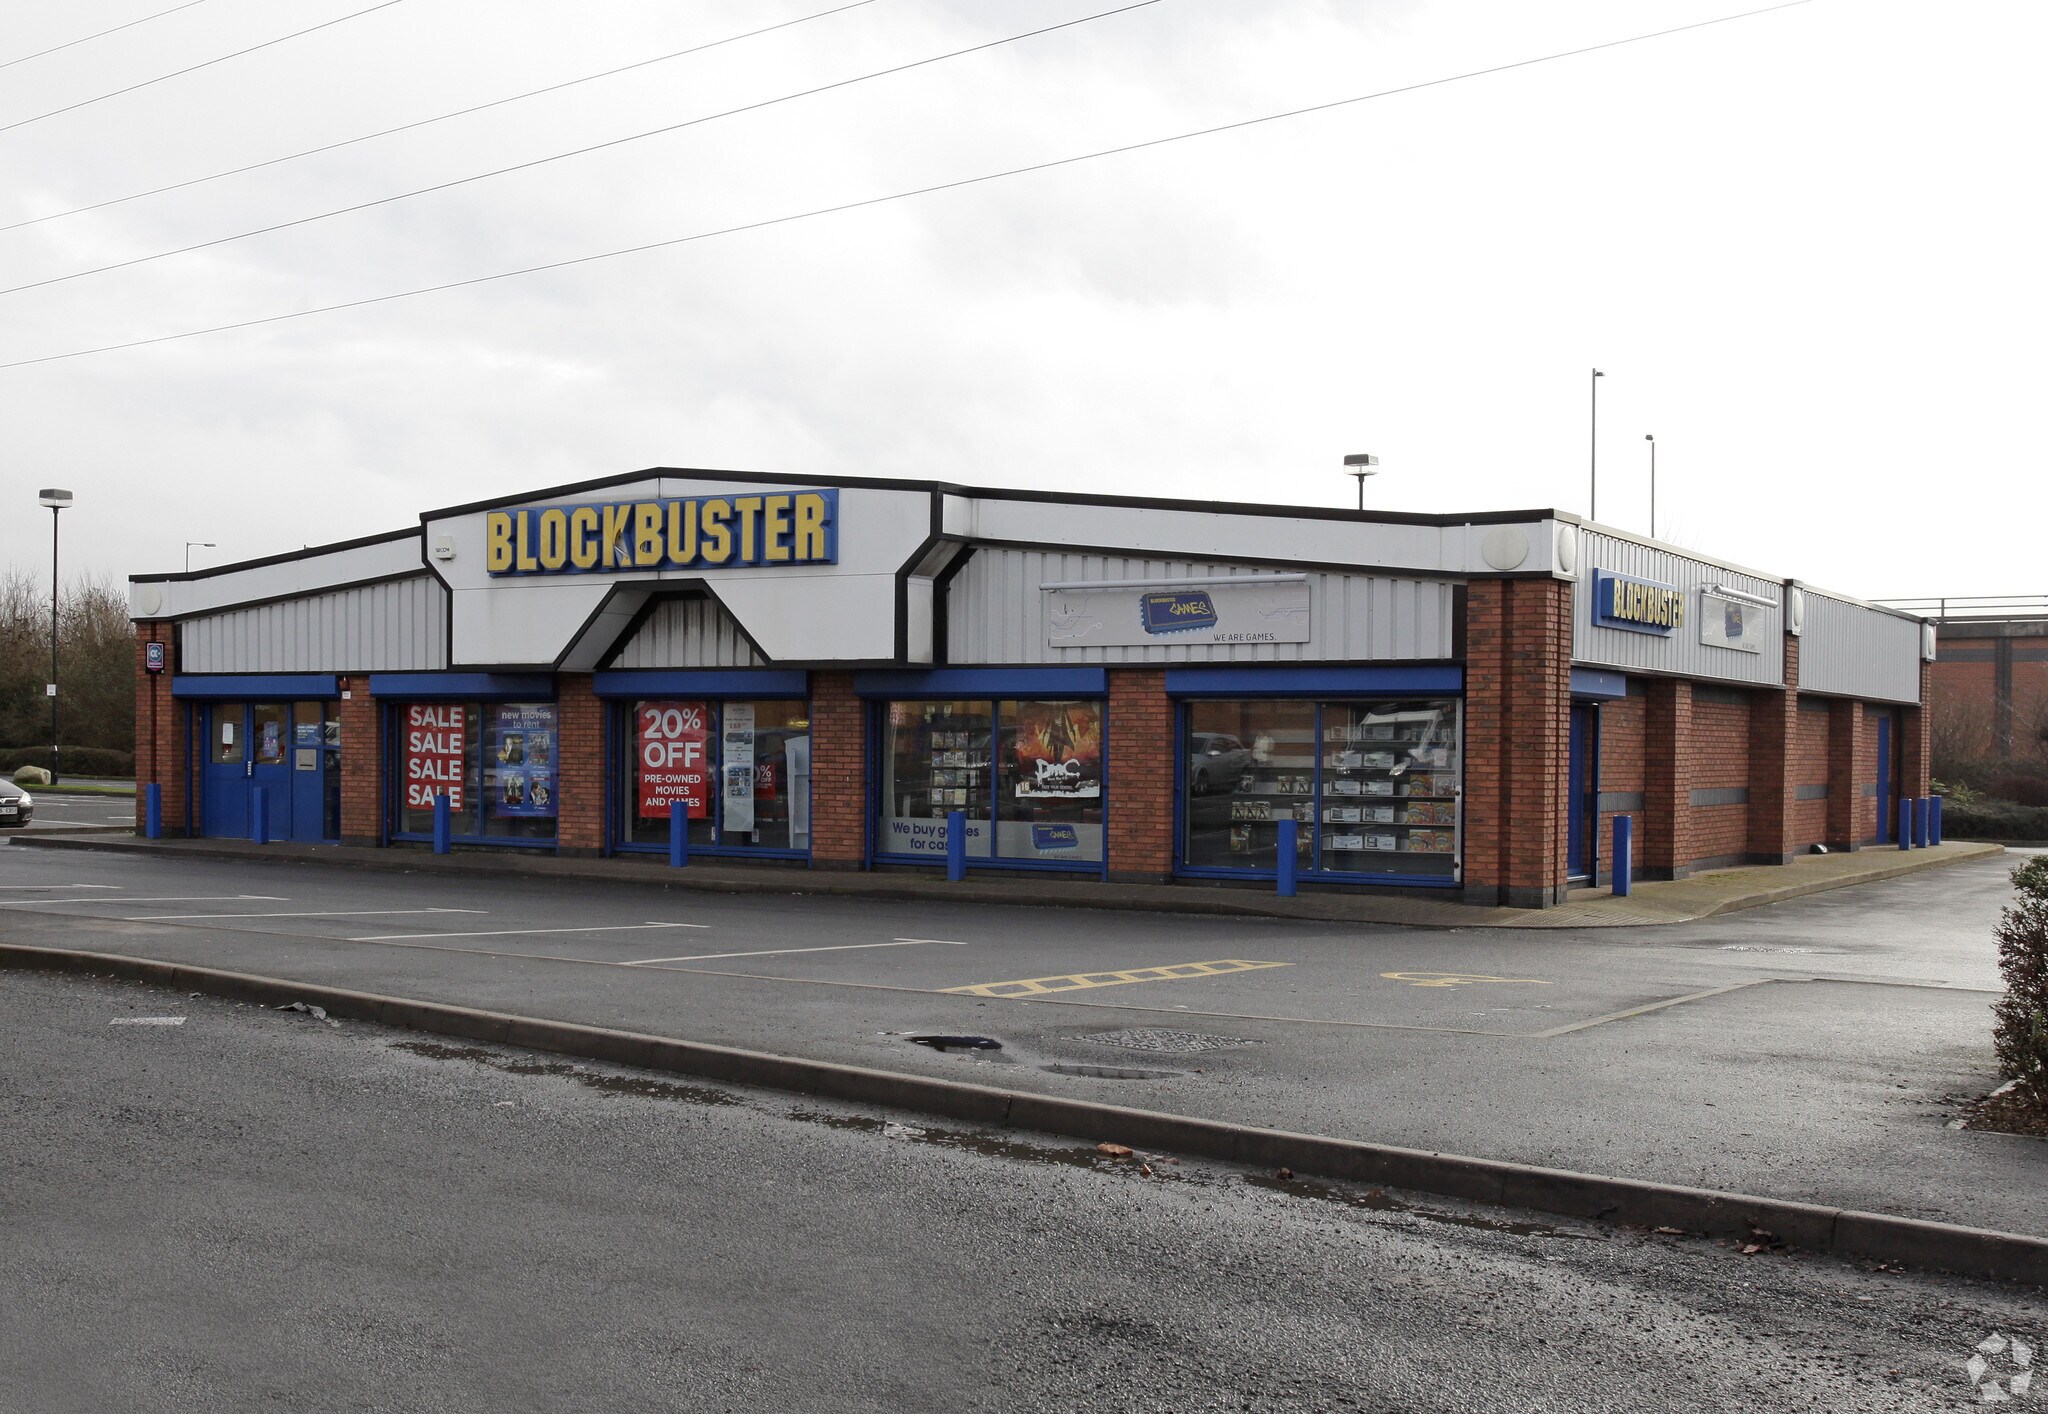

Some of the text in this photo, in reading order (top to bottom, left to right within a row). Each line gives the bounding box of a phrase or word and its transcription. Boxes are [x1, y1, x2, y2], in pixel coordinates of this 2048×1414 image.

[487, 493, 829, 573] BLOCKBUSTER
[1169, 601, 1211, 616] GAMES
[1613, 578, 1685, 628] BLOCKBUSTER
[1213, 632, 1277, 642] WE ARE GAMES.
[409, 705, 463, 728] SALE
[501, 710, 552, 720] new movies
[513, 721, 521, 729] to
[644, 707, 702, 739] 20%
[409, 732, 462, 754] SALE
[644, 742, 702, 768] OFF
[408, 758, 462, 781] SALE
[644, 774, 701, 784] PRE-OWNED
[1021, 781, 1030, 791] 16
[408, 784, 461, 808] SAE
[655, 786, 690, 795] MOVIES
[645, 797, 700, 807] AND GES
[892, 822, 980, 838] We buy ges
[910, 838, 949, 850] for cas
